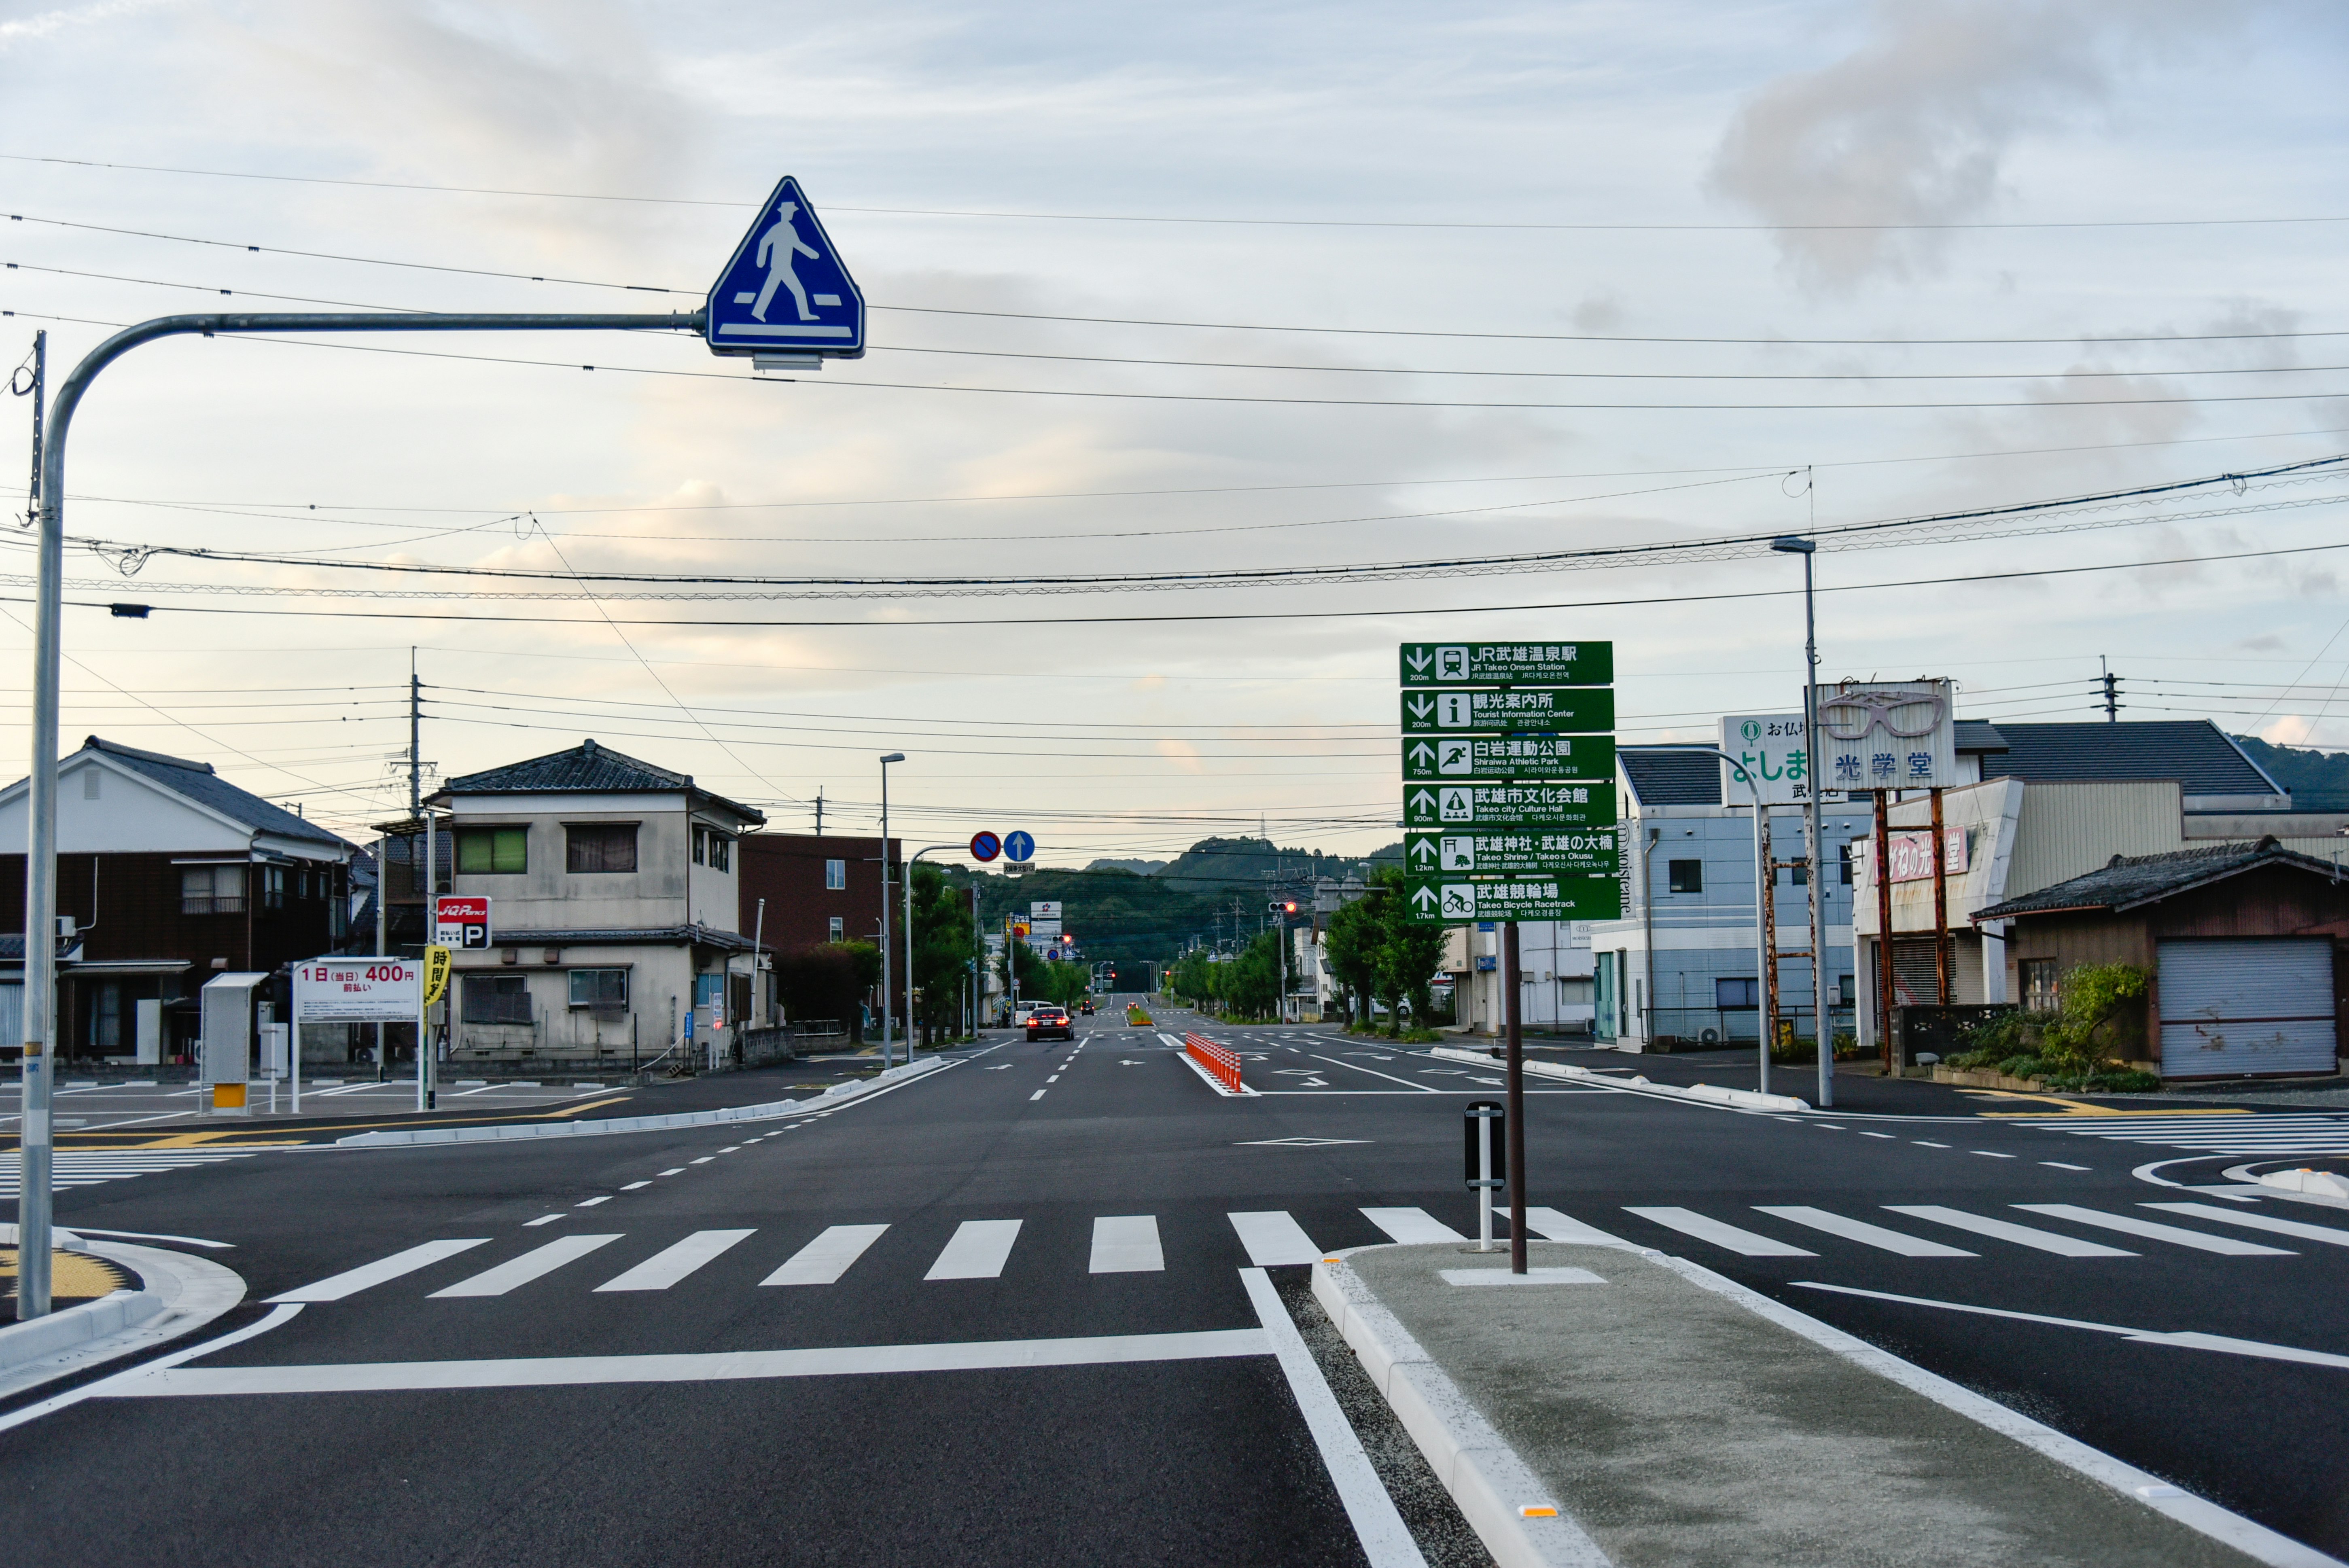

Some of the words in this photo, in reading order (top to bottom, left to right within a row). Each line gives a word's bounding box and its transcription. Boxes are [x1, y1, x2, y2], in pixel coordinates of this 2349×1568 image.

[1470, 646, 1577, 662] JR武雄温泉駅
[1472, 693, 1553, 709] 観光案内所
[1474, 740, 1571, 756] 白岩運動公園
[1836, 752, 1932, 780] 光学堂
[1474, 788, 1588, 803] 武雄市文化会館
[1501, 805, 1516, 814] city
[1475, 834, 1613, 852] 武雄神社・武雄の大楠
[1876, 832, 1960, 879] がねの光堂
[1476, 883, 1558, 899] 武雄競輪場
[1504, 901, 1533, 909] Bicycle
[466, 926, 483, 945] P
[343, 983, 372, 992] 前払い
